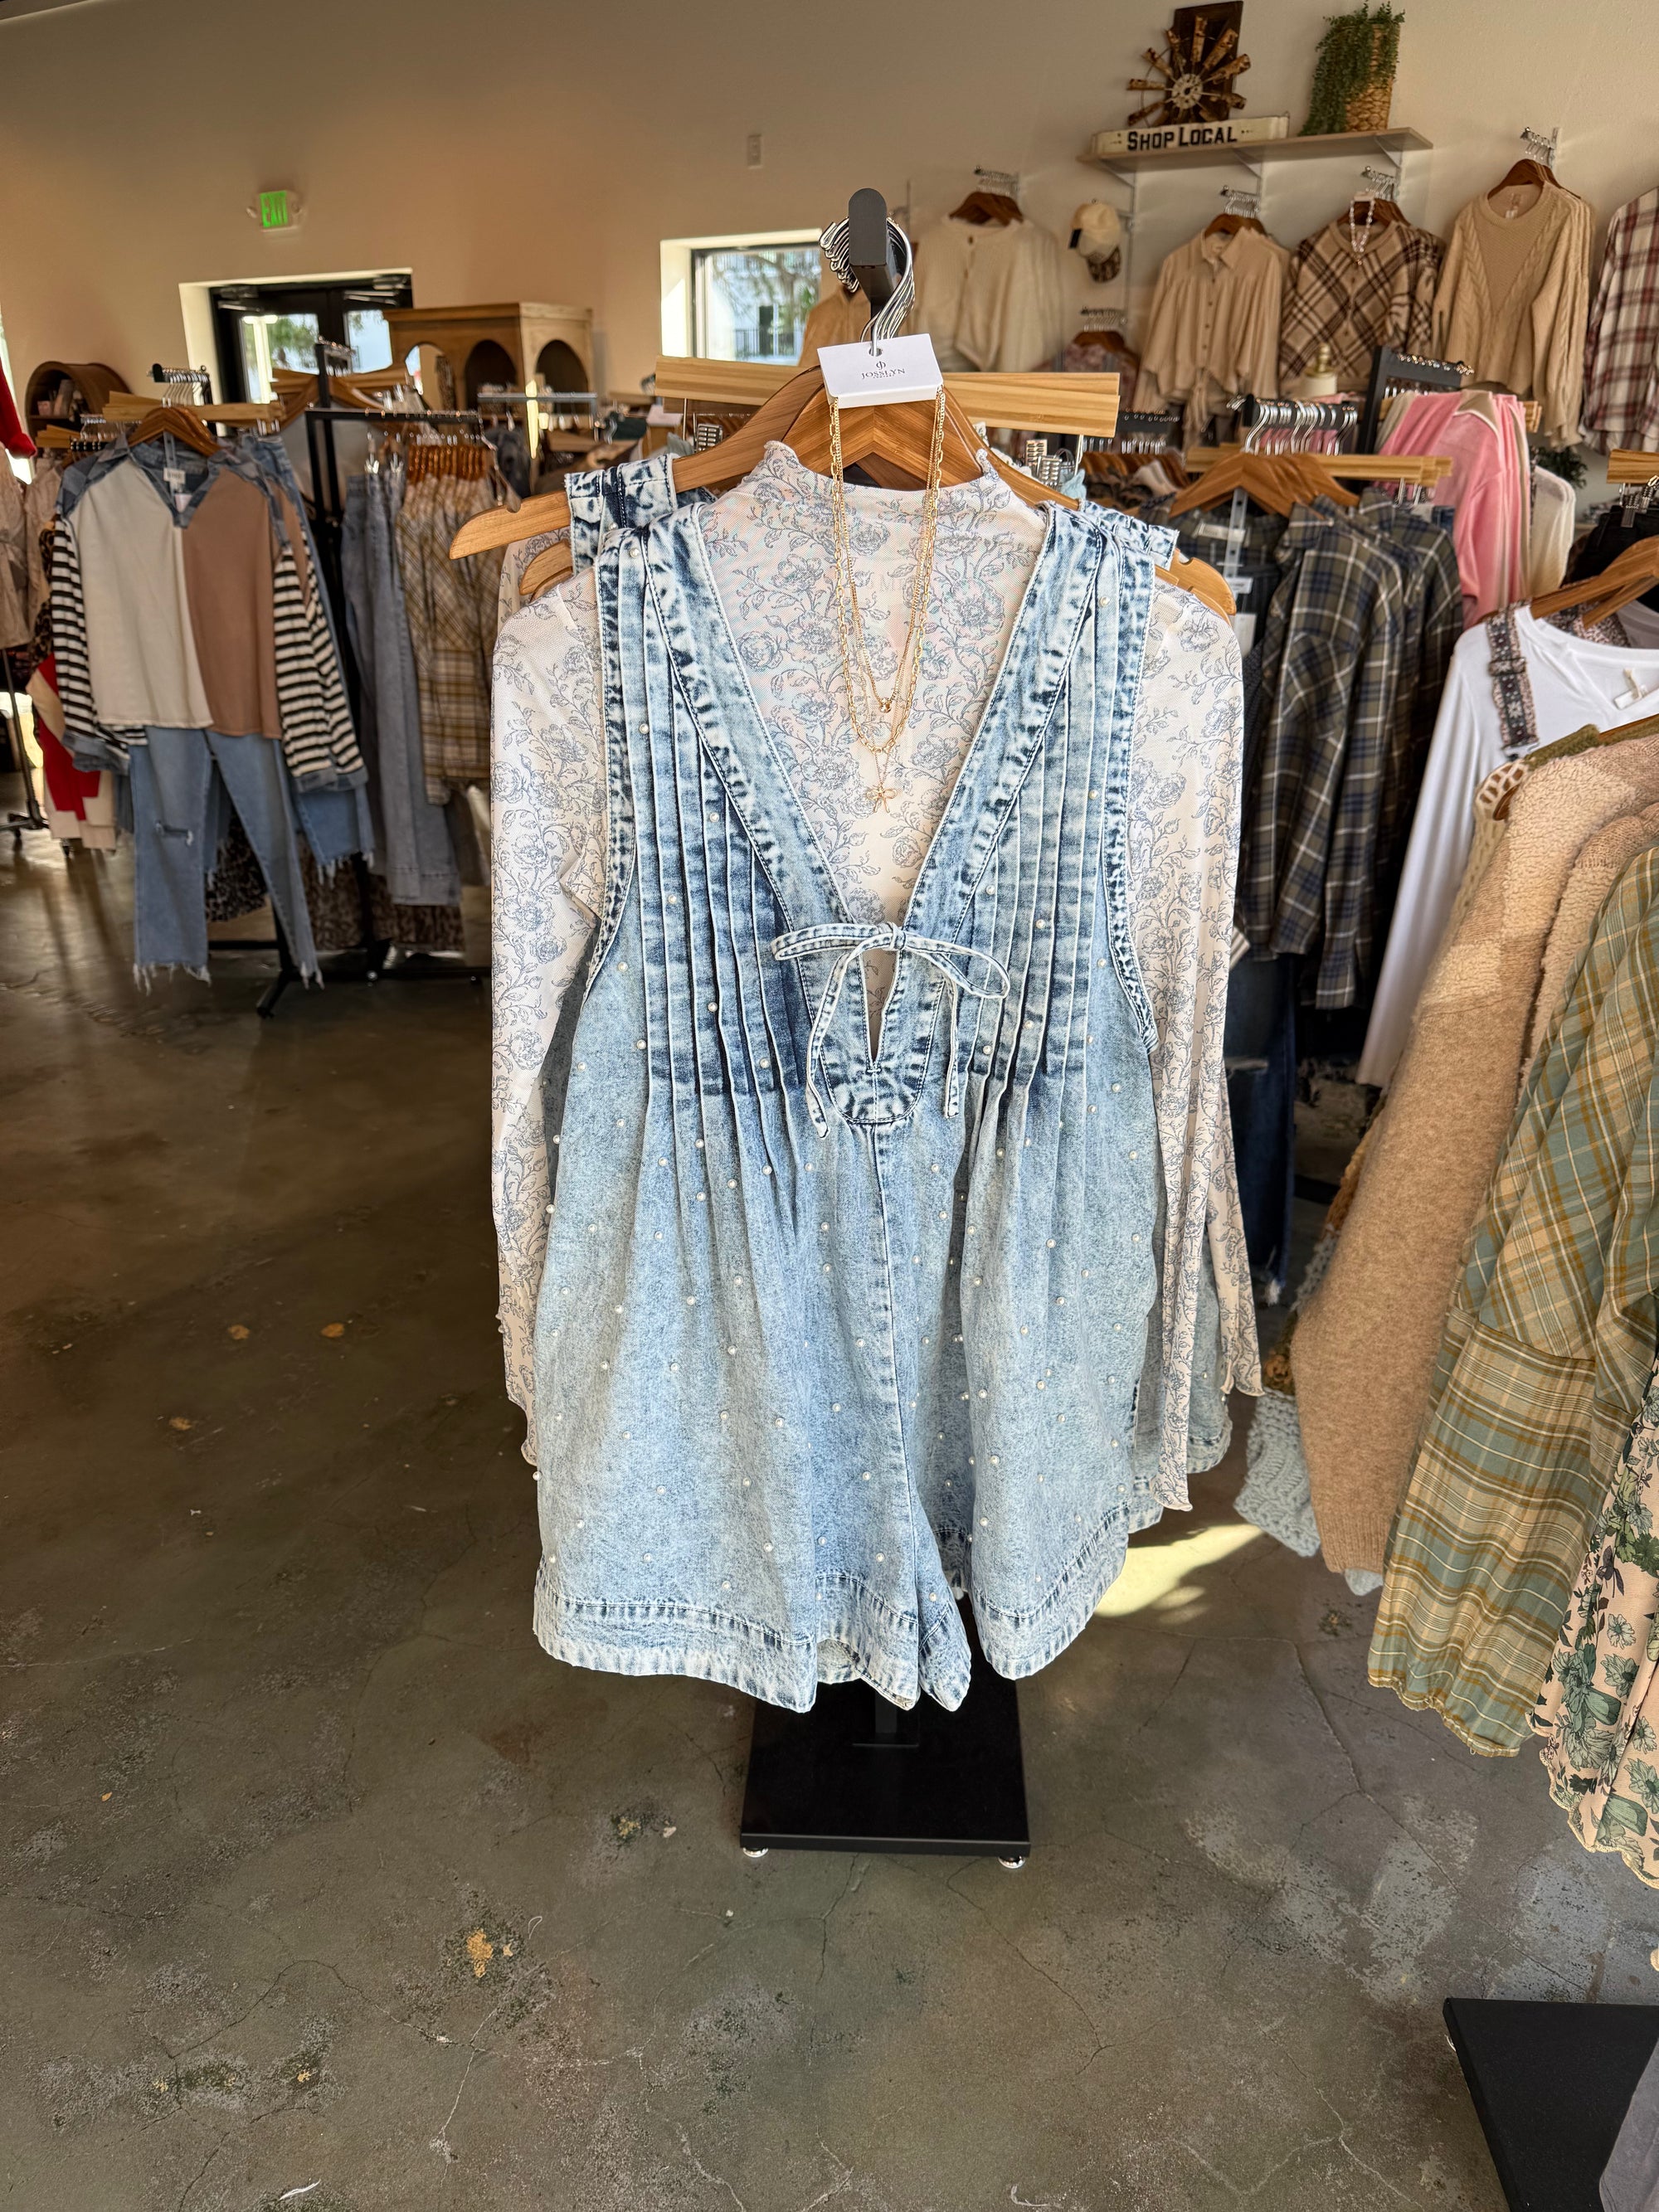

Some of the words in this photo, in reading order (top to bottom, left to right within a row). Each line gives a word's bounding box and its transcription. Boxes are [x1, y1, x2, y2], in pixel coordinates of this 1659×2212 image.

[1127, 130, 1175, 151] SHOP
[1178, 126, 1238, 147] LOCAL
[260, 190, 288, 228] EXIT
[861, 367, 905, 379] JOSSLYN
